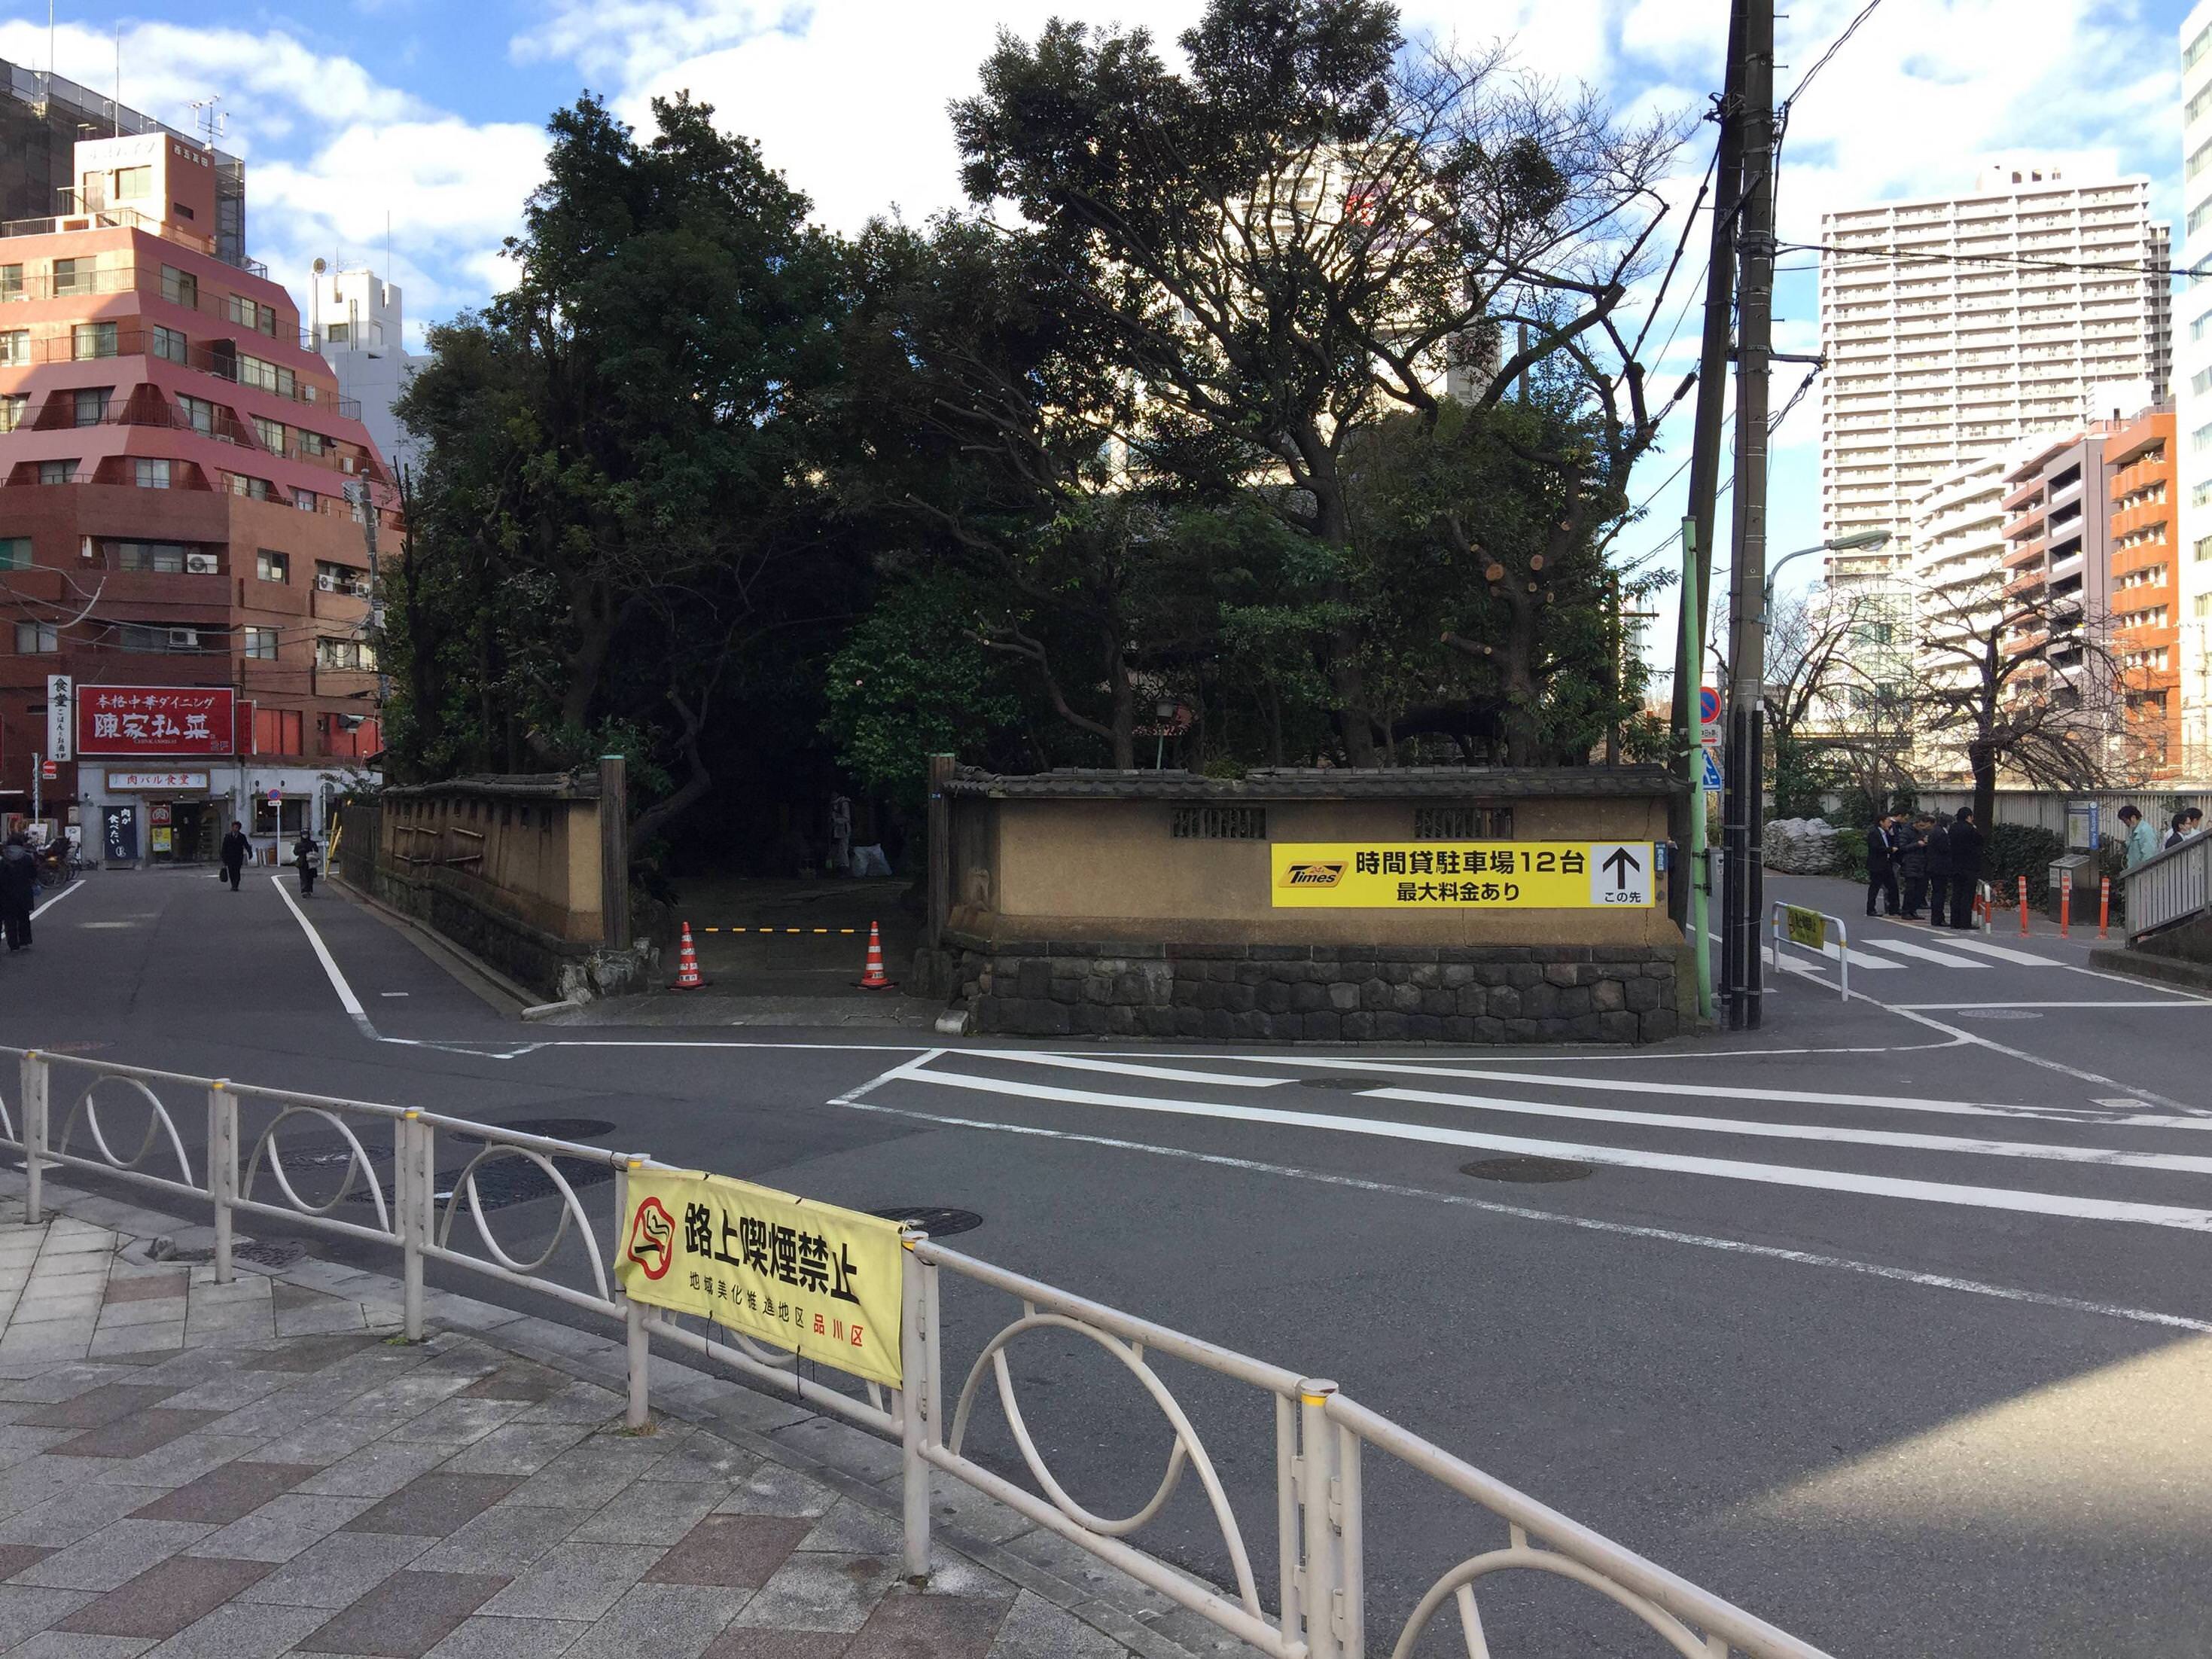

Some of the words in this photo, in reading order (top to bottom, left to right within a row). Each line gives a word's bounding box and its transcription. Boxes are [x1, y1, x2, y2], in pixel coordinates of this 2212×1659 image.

[174, 144, 208, 167] 西五反田
[53, 678, 68, 707] 食堂
[96, 694, 215, 710] 本格中華ダイニング
[93, 712, 211, 740] 陳家私菜
[126, 774, 190, 785] 肉バル食堂
[120, 808, 132, 825] 肉が
[108, 813, 120, 844] 食べたい
[1356, 849, 1586, 875] 時間貸駐車場12台
[1288, 865, 1337, 884] Times
[1397, 882, 1519, 902] 最大料金あり
[1604, 891, 1641, 903] この先
[684, 1202, 861, 1307] 路上喫煙禁止
